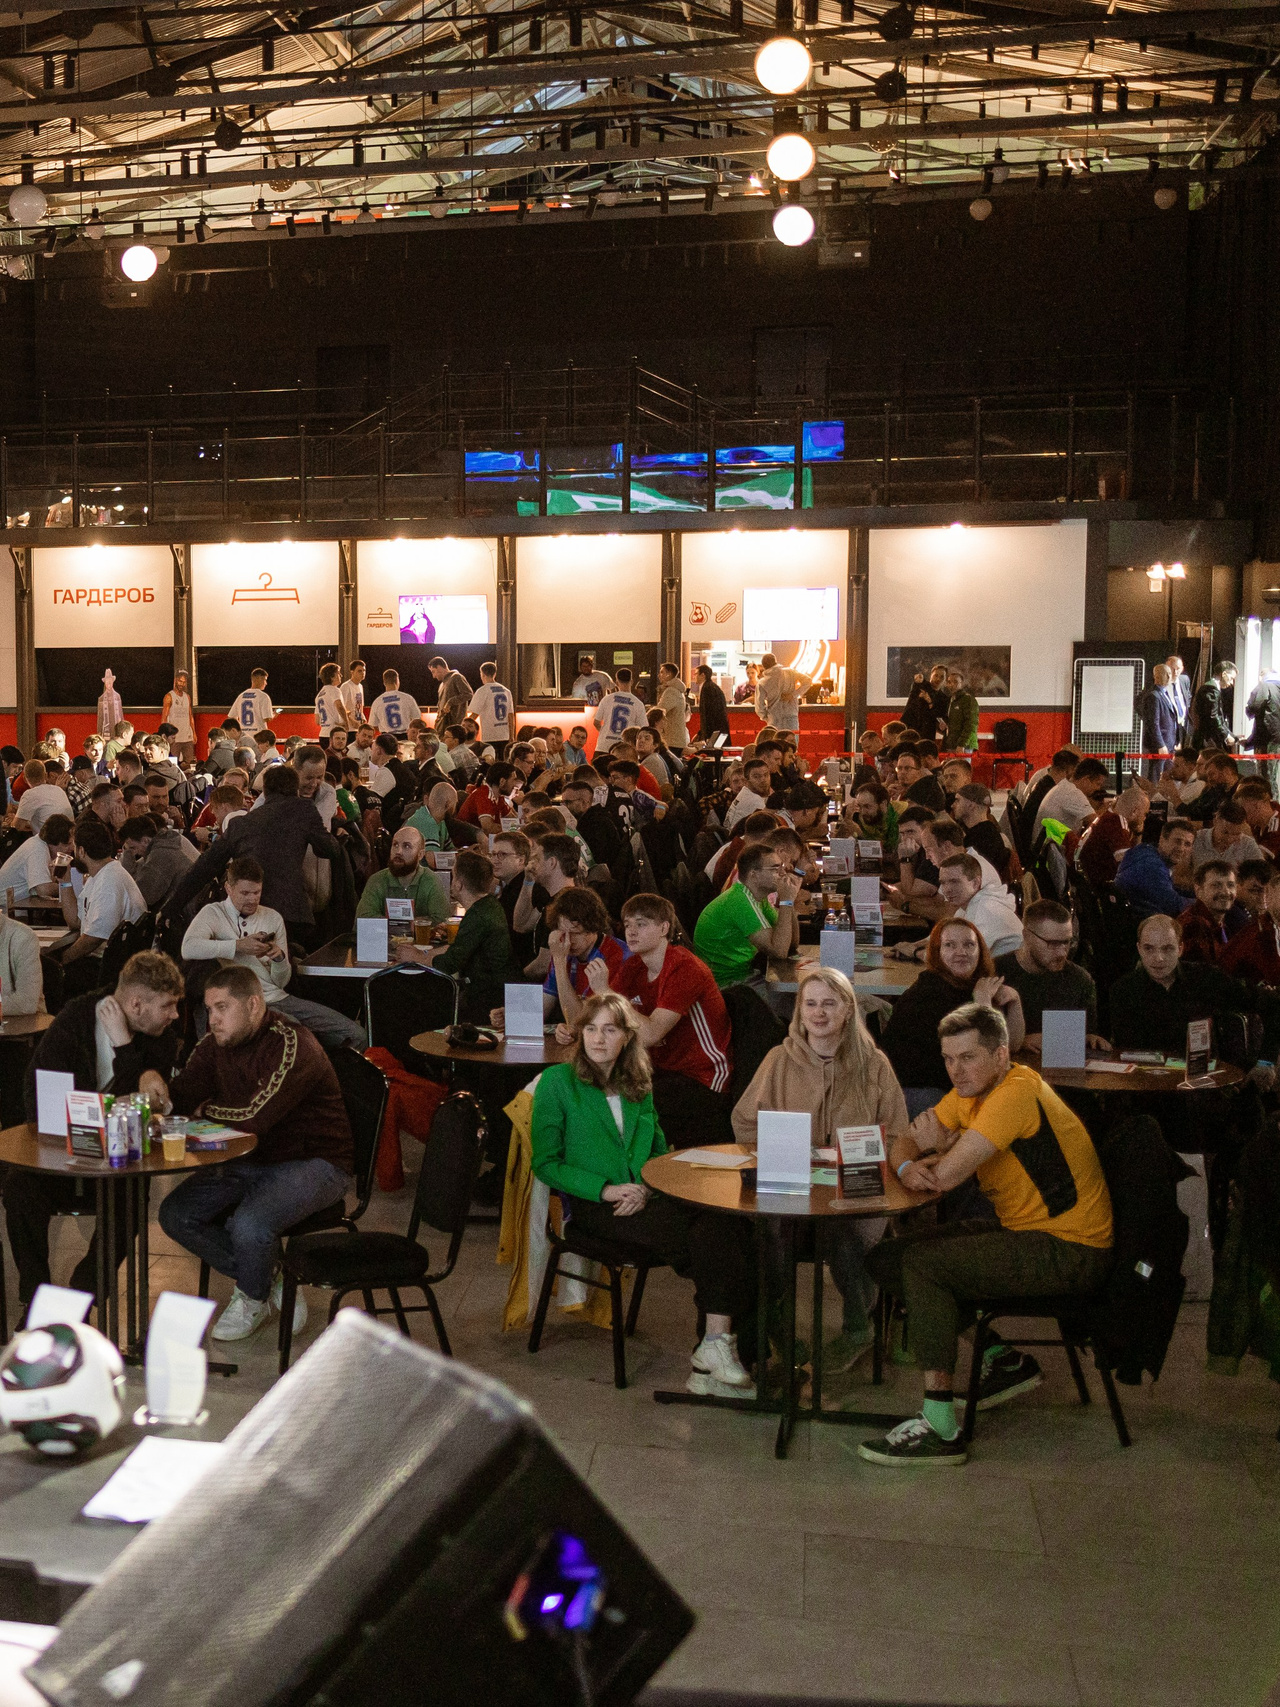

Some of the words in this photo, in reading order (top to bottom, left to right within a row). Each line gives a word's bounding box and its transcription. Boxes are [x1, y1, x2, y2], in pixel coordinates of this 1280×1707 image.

[53, 588, 155, 606] ГАРДЕРОБ
[241, 700, 255, 726] 6
[385, 703, 402, 729] 6
[493, 694, 507, 721] 6
[610, 704, 630, 735] 6
